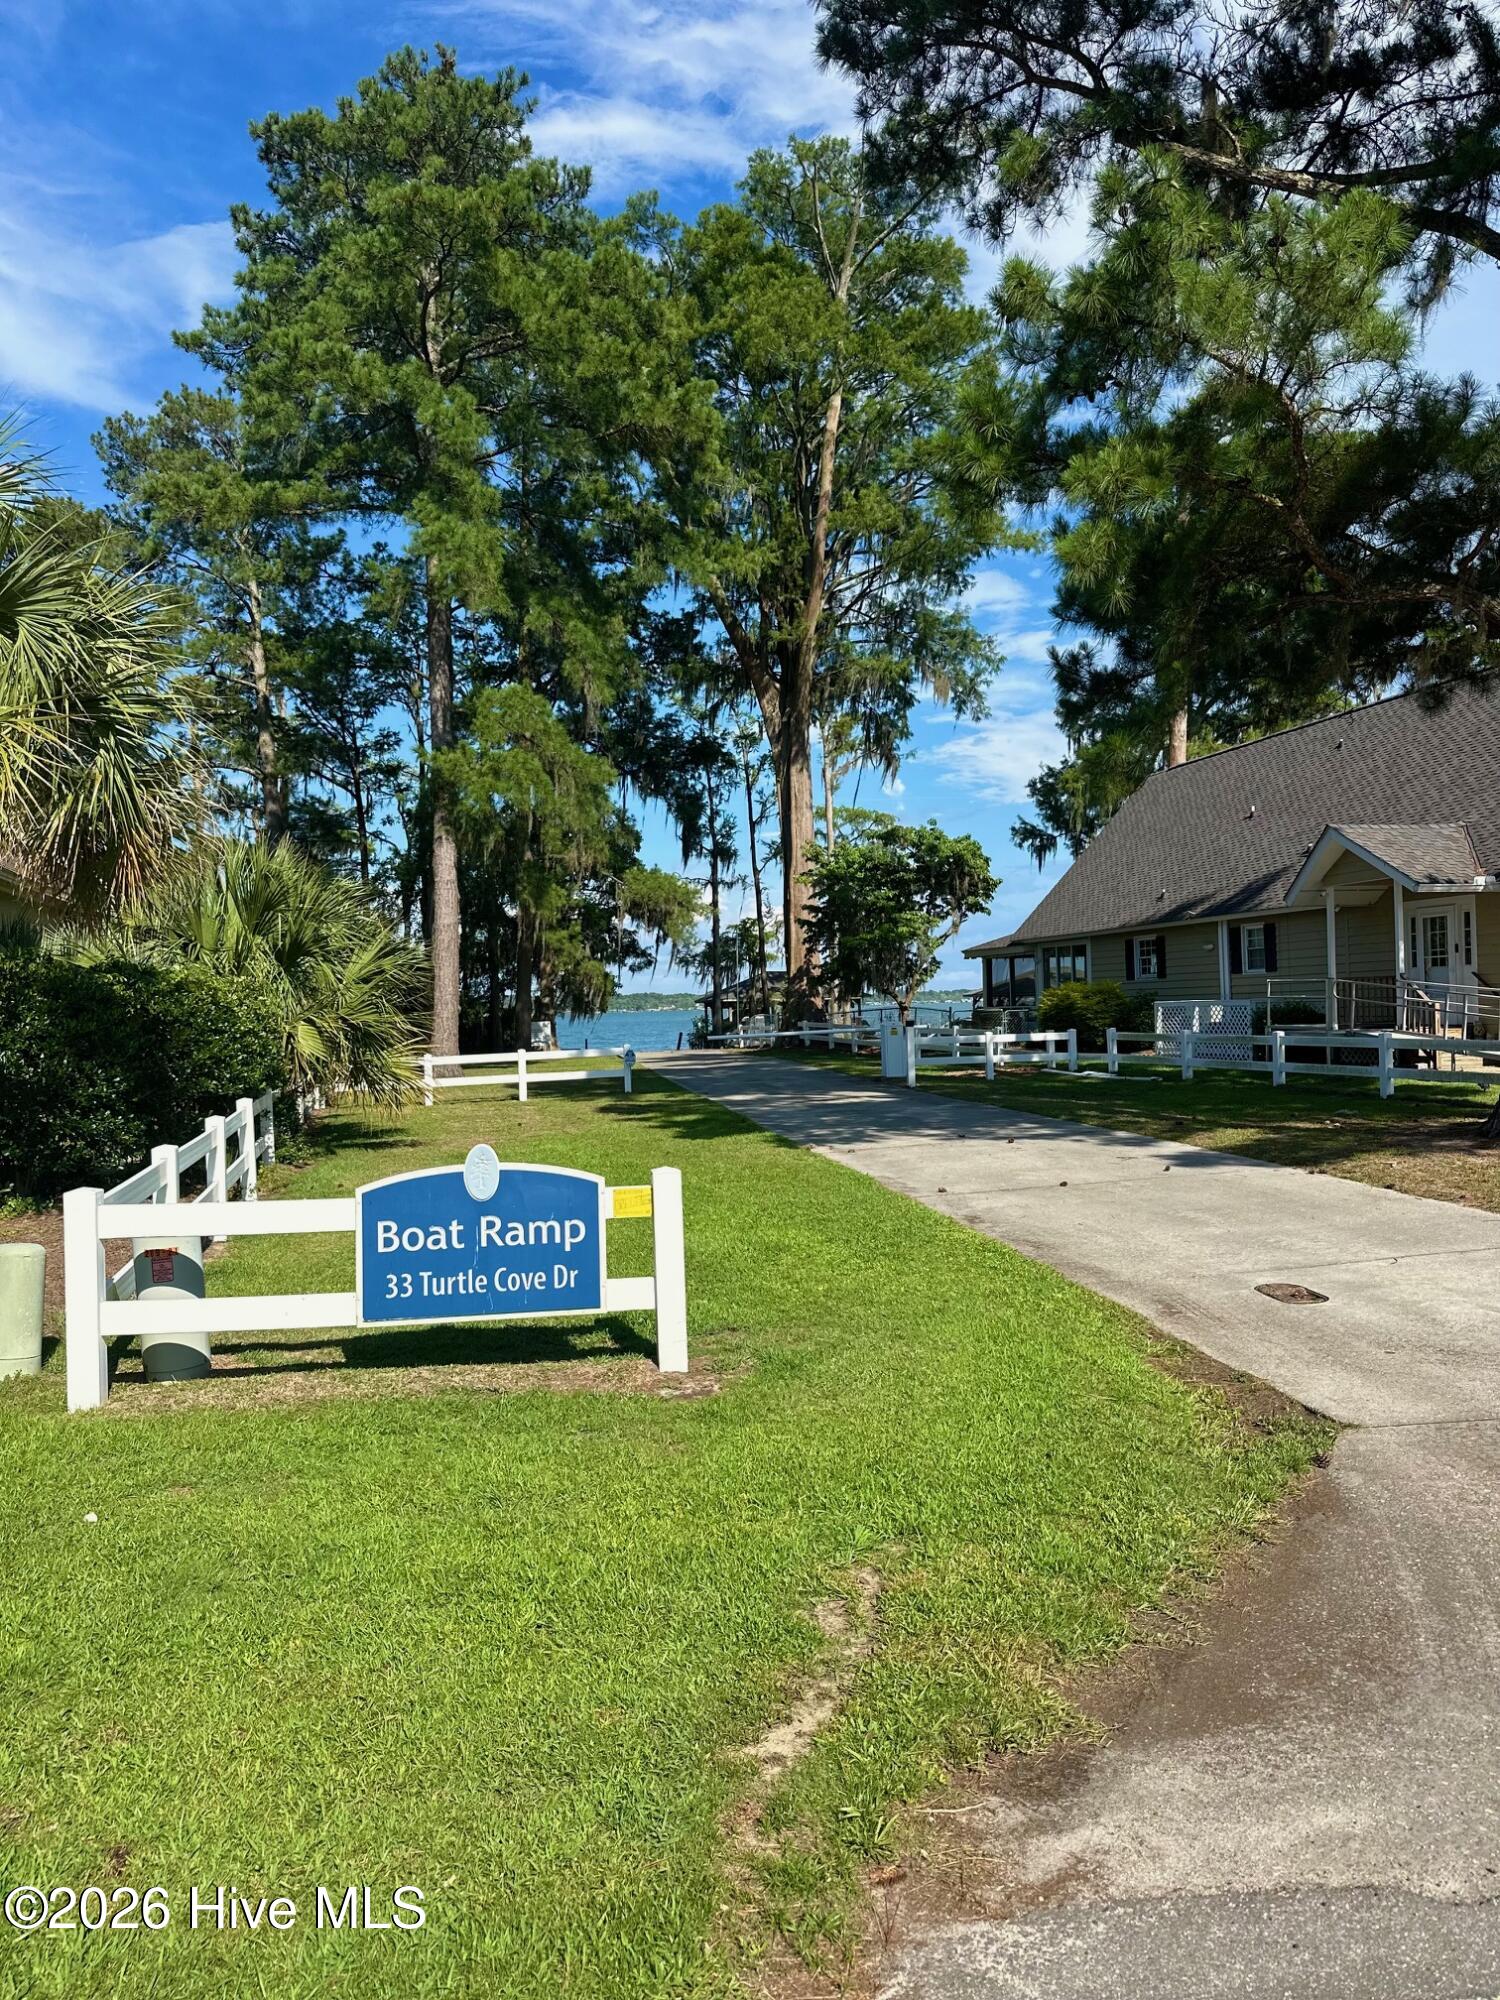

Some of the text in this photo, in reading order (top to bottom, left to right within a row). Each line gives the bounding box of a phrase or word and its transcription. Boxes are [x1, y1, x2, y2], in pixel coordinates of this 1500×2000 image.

[377, 1215, 586, 1253] Boat Ramp
[385, 1264, 578, 1299] 33 Turtle Cove Dr
